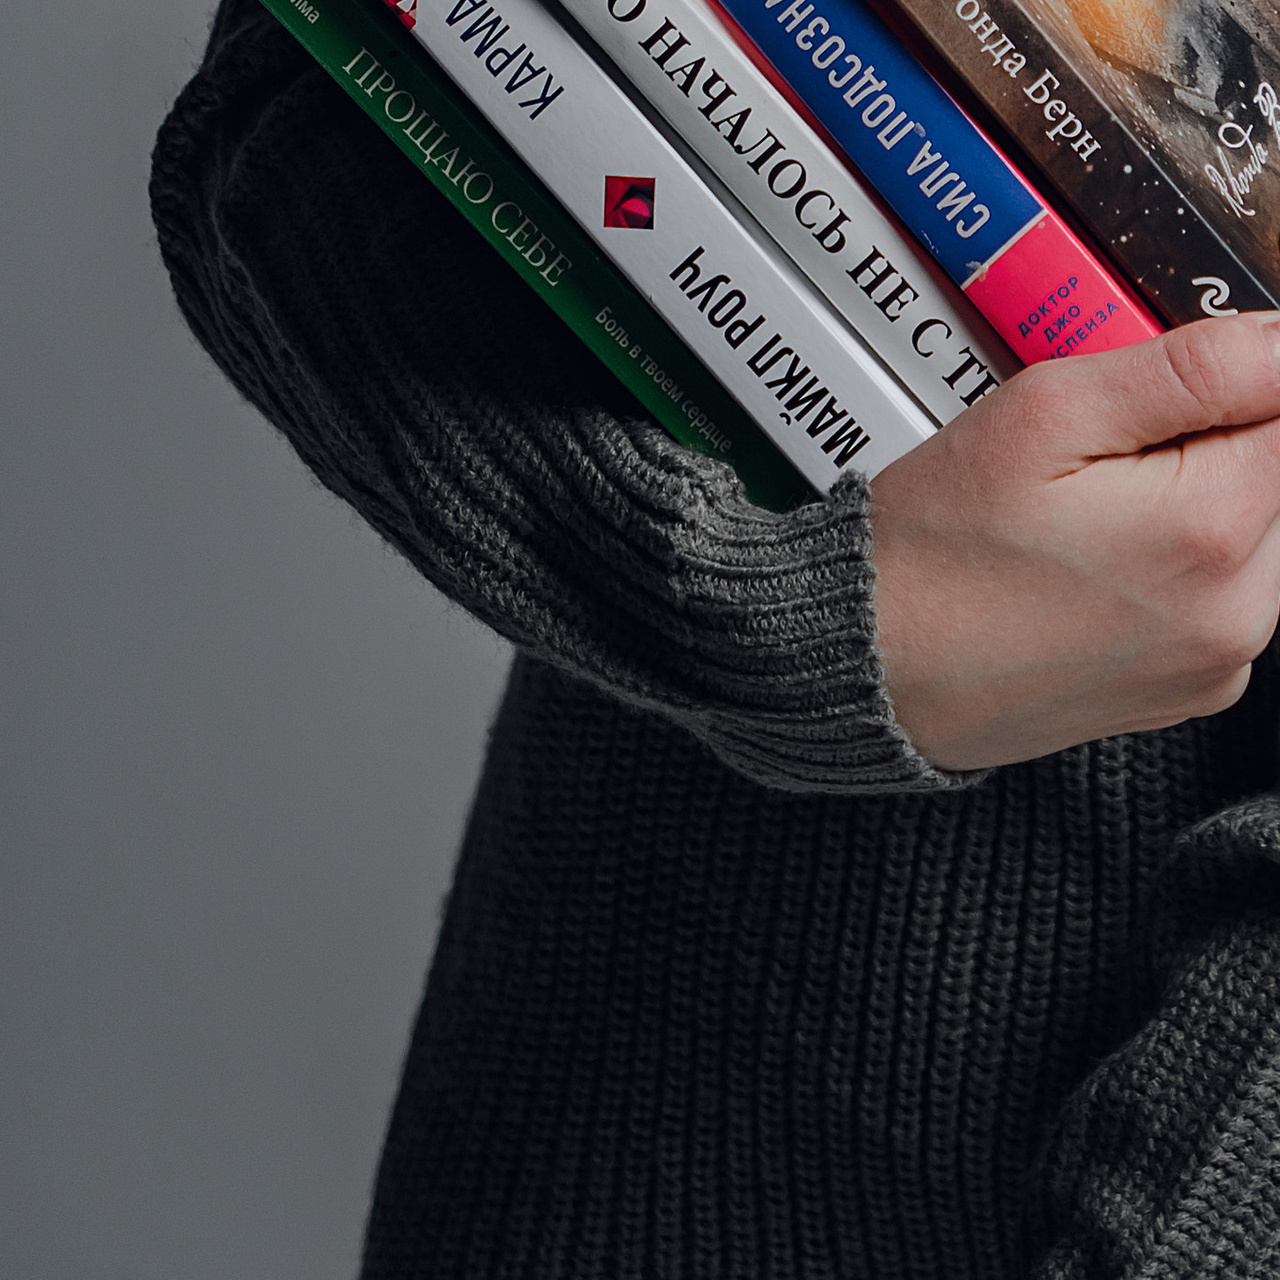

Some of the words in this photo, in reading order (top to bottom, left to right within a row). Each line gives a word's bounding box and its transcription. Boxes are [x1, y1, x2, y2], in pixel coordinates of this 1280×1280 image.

[342, 46, 494, 204] ПРОЩАЮ
[491, 201, 573, 287] СЕБЕ
[1023, 68, 1102, 162] Берн
[638, 16, 852, 254] НАЧАЛОСЬ
[845, 245, 920, 323] НЕ
[911, 318, 953, 358] С
[907, 140, 991, 238] СИЛА
[669, 245, 766, 350] РОУЧ
[1018, 276, 1079, 339] ДОКТОР
[1043, 305, 1081, 344] ДЖО
[594, 306, 629, 349] Боль
[628, 345, 641, 359] в
[639, 352, 683, 403] твоем
[681, 397, 733, 454] сердце
[746, 333, 872, 469] МАЙКЛ
